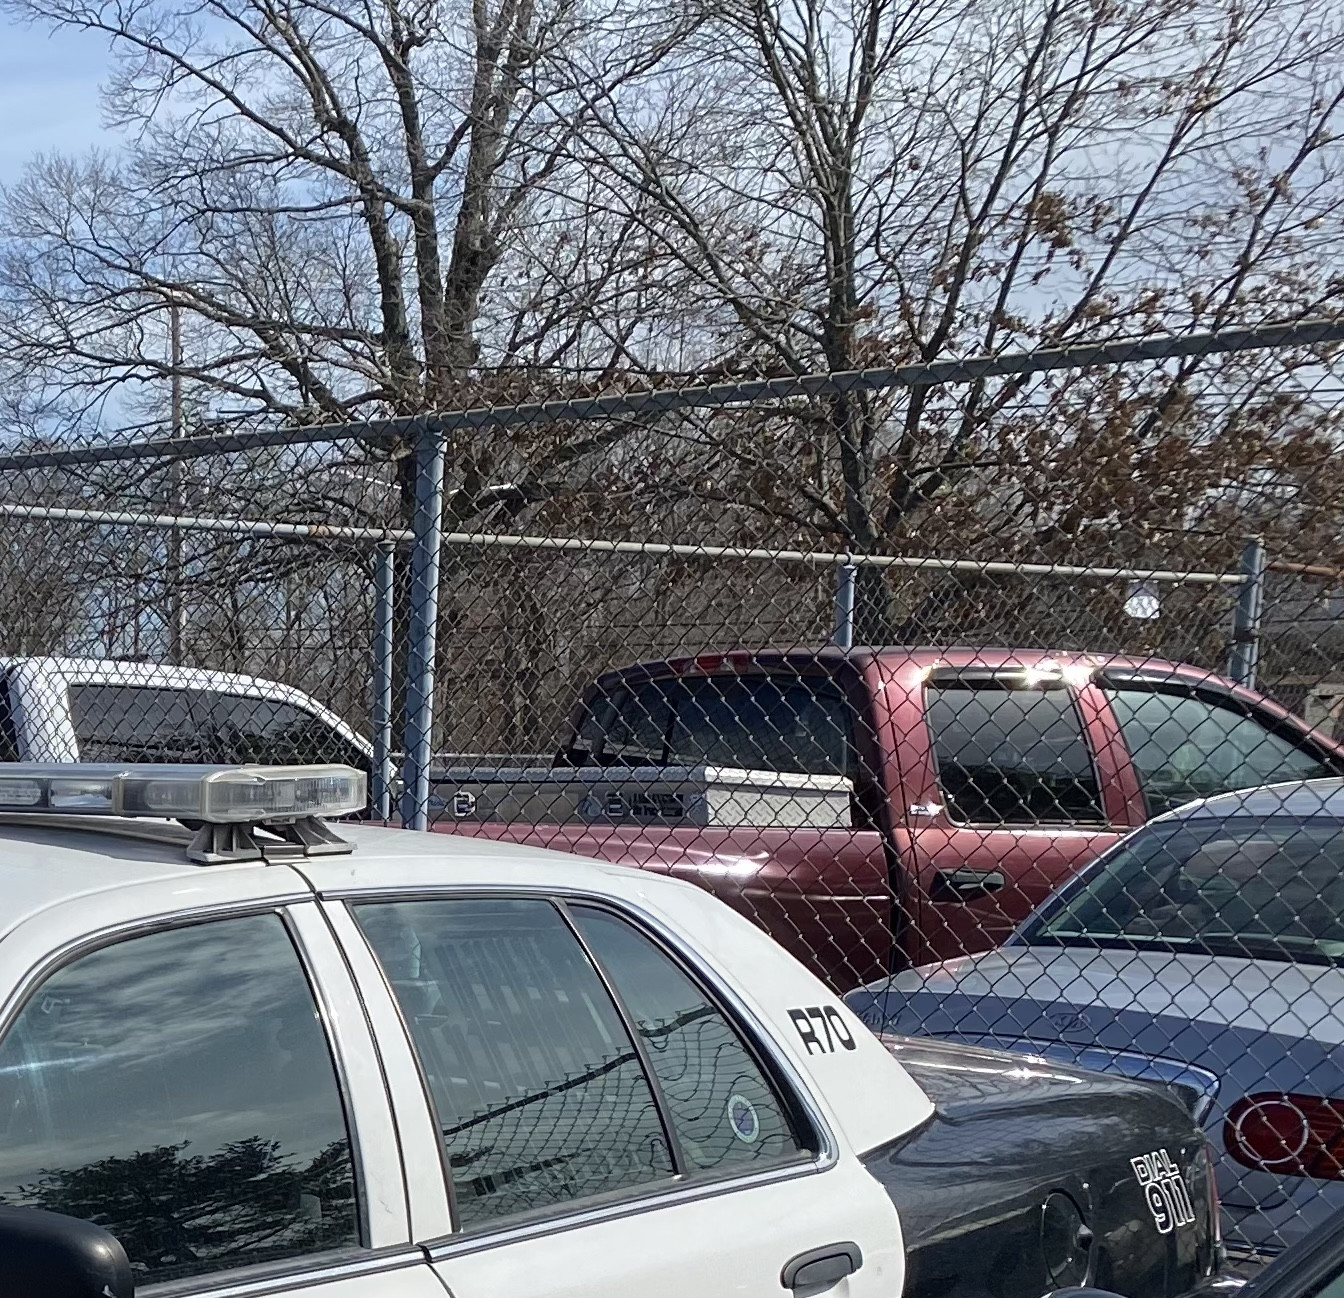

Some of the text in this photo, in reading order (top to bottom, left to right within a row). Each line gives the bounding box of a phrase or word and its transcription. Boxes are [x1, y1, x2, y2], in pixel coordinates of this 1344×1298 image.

[785, 1005, 857, 1056] R70
[1130, 1148, 1180, 1187] DIAL
[1144, 1174, 1196, 1234] 911
